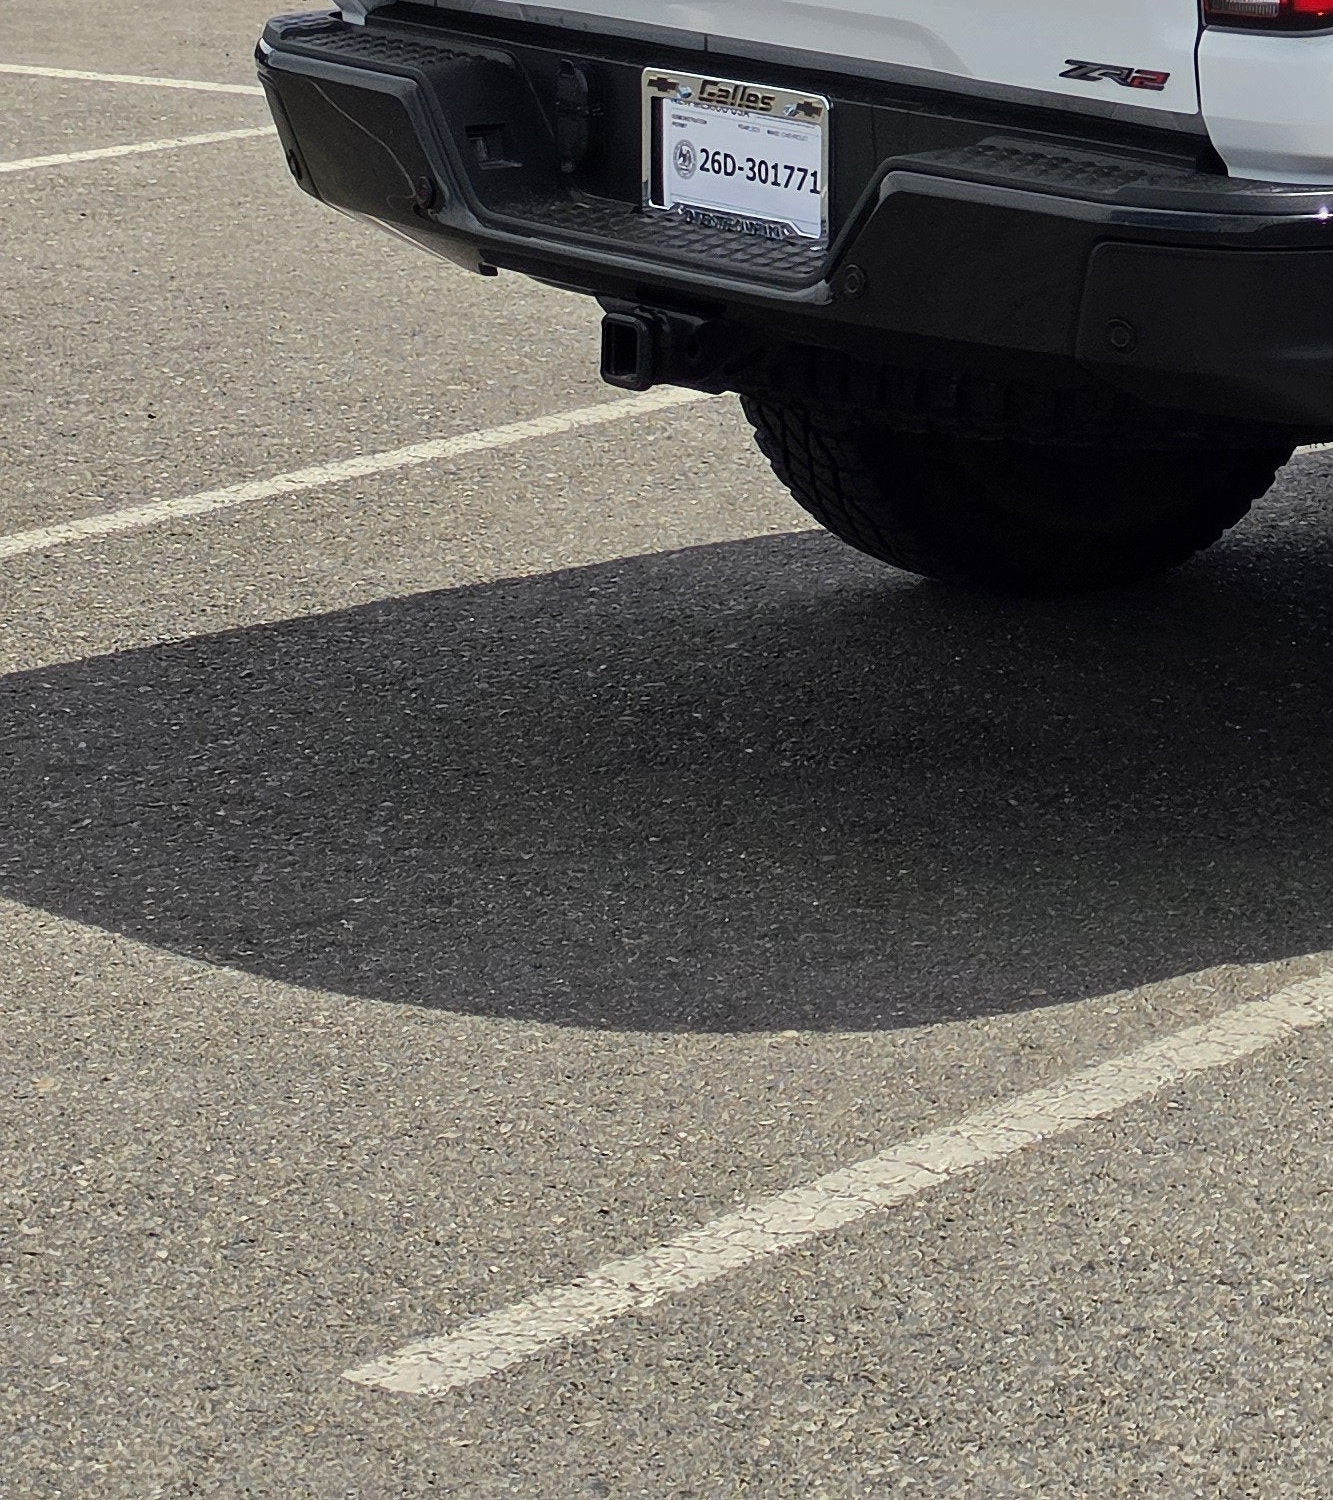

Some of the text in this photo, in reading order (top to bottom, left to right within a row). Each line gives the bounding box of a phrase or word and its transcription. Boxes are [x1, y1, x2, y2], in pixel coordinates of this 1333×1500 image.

[1059, 58, 1171, 92] ZR2
[698, 79, 776, 112] Galles
[699, 148, 821, 195] 26D-301771
